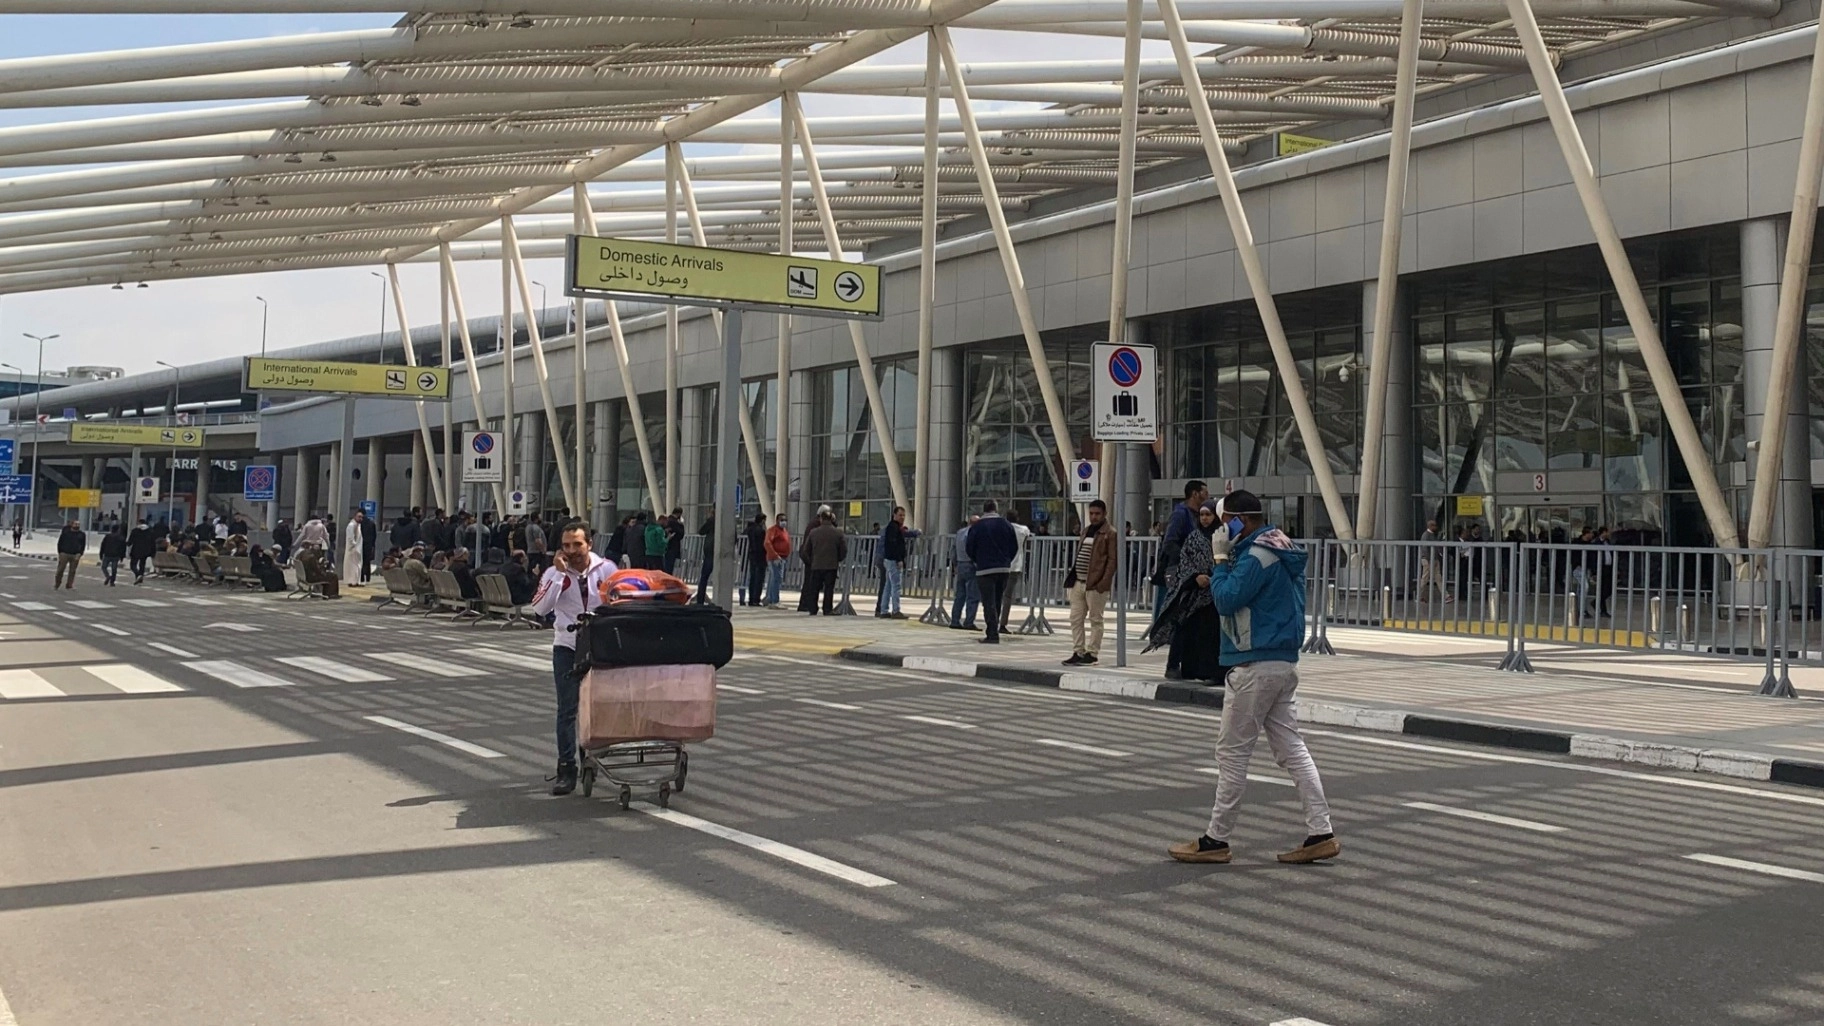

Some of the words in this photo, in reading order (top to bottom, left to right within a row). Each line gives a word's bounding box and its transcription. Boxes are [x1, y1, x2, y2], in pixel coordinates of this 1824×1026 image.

[600, 247, 668, 267] Domestic
[671, 253, 724, 272] Arrivals
[647, 270, 689, 289] وصول
[263, 363, 321, 375] International
[323, 366, 358, 377] Arrivals
[287, 375, 315, 387] وصول
[171, 458, 237, 471] ARRALS
[1226, 480, 1232, 492] 4
[1535, 474, 1544, 490] 3
